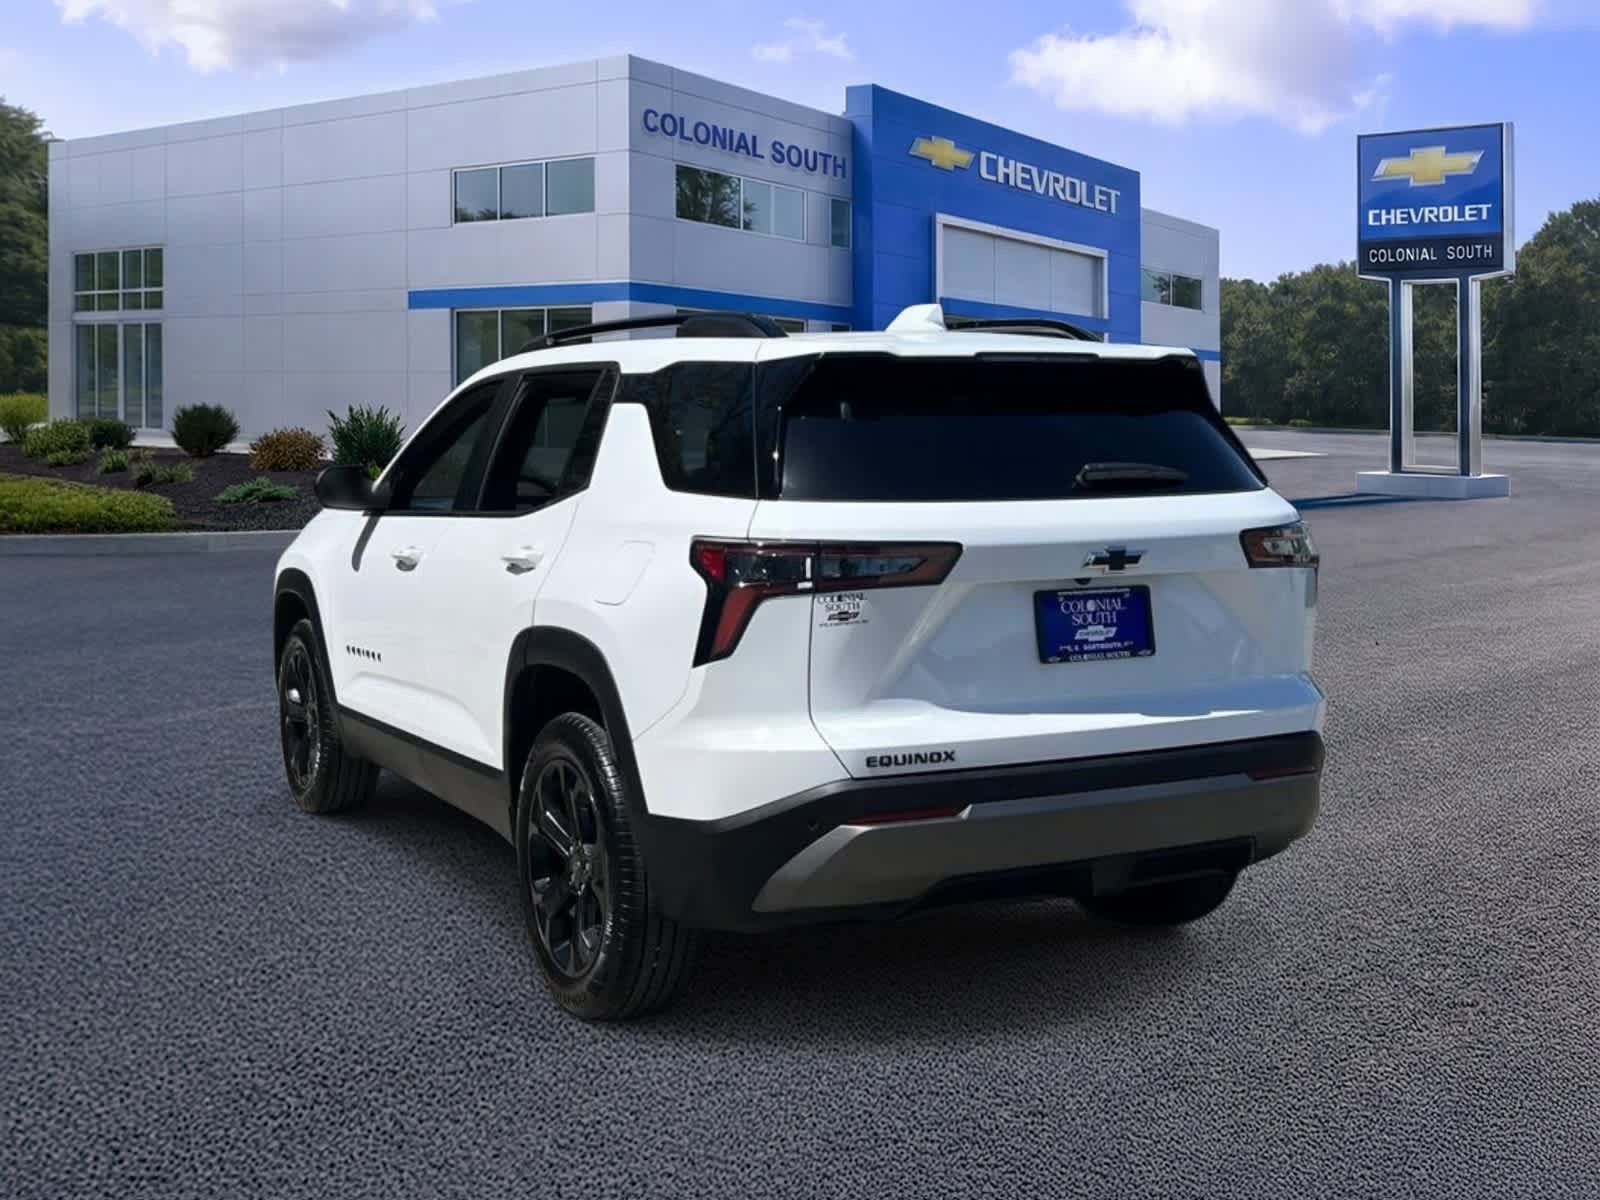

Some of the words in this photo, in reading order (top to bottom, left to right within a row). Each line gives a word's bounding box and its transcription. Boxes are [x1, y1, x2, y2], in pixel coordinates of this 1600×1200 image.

[643, 109, 764, 159] COLONIAL
[771, 141, 847, 179] SOUTH
[979, 151, 1121, 214] CHEVROLET
[1368, 204, 1492, 226] CHEVROLET
[1369, 248, 1437, 263] COLONIAL
[1447, 245, 1493, 260] SOUTH
[1060, 598, 1127, 614] COLONIAL
[1072, 611, 1117, 626] SOUTH
[866, 751, 955, 768] EQUINOX
